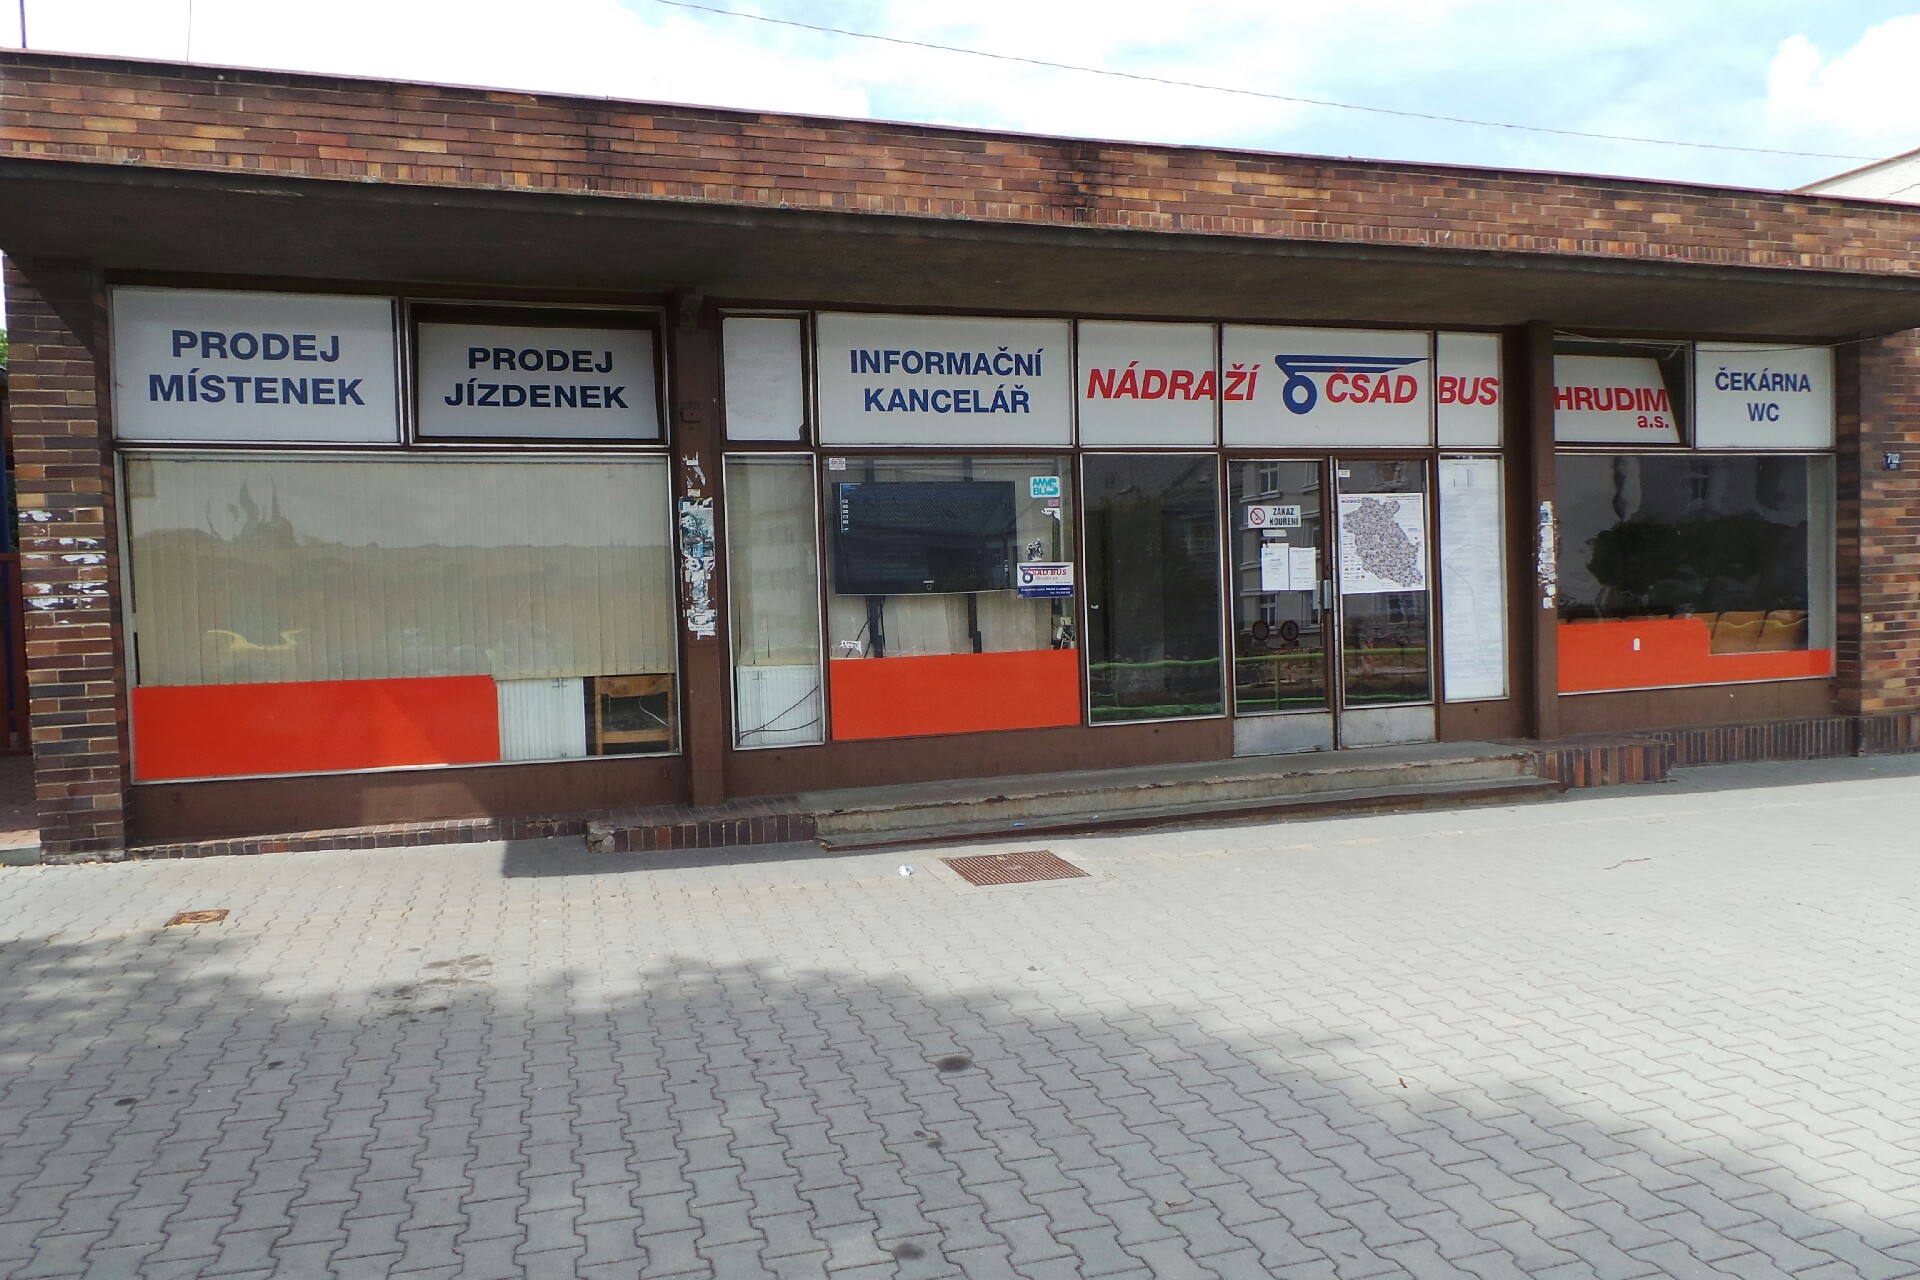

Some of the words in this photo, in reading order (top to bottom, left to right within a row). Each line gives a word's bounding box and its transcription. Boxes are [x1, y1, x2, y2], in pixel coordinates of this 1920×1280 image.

[172, 330, 339, 362] PRODEJ
[468, 347, 613, 373] PRODEJ
[850, 346, 1044, 376] INFORMAČNÍ
[149, 368, 365, 405] MÍSTENEK
[1087, 361, 1261, 400] NÁDRAŽÍ
[1325, 367, 1418, 403] ČSAD
[1438, 376, 1499, 405] BUS
[1714, 367, 1811, 392] ČEKÁRNA
[444, 378, 628, 409] JÍZDENEK
[864, 384, 1030, 413] KANCELÁŘ
[1637, 415, 1669, 428] a.s.
[1747, 403, 1779, 422] WC
[1270, 516, 1298, 526] KOUŘENÍ
[1273, 507, 1294, 515] ZÁKAZ
